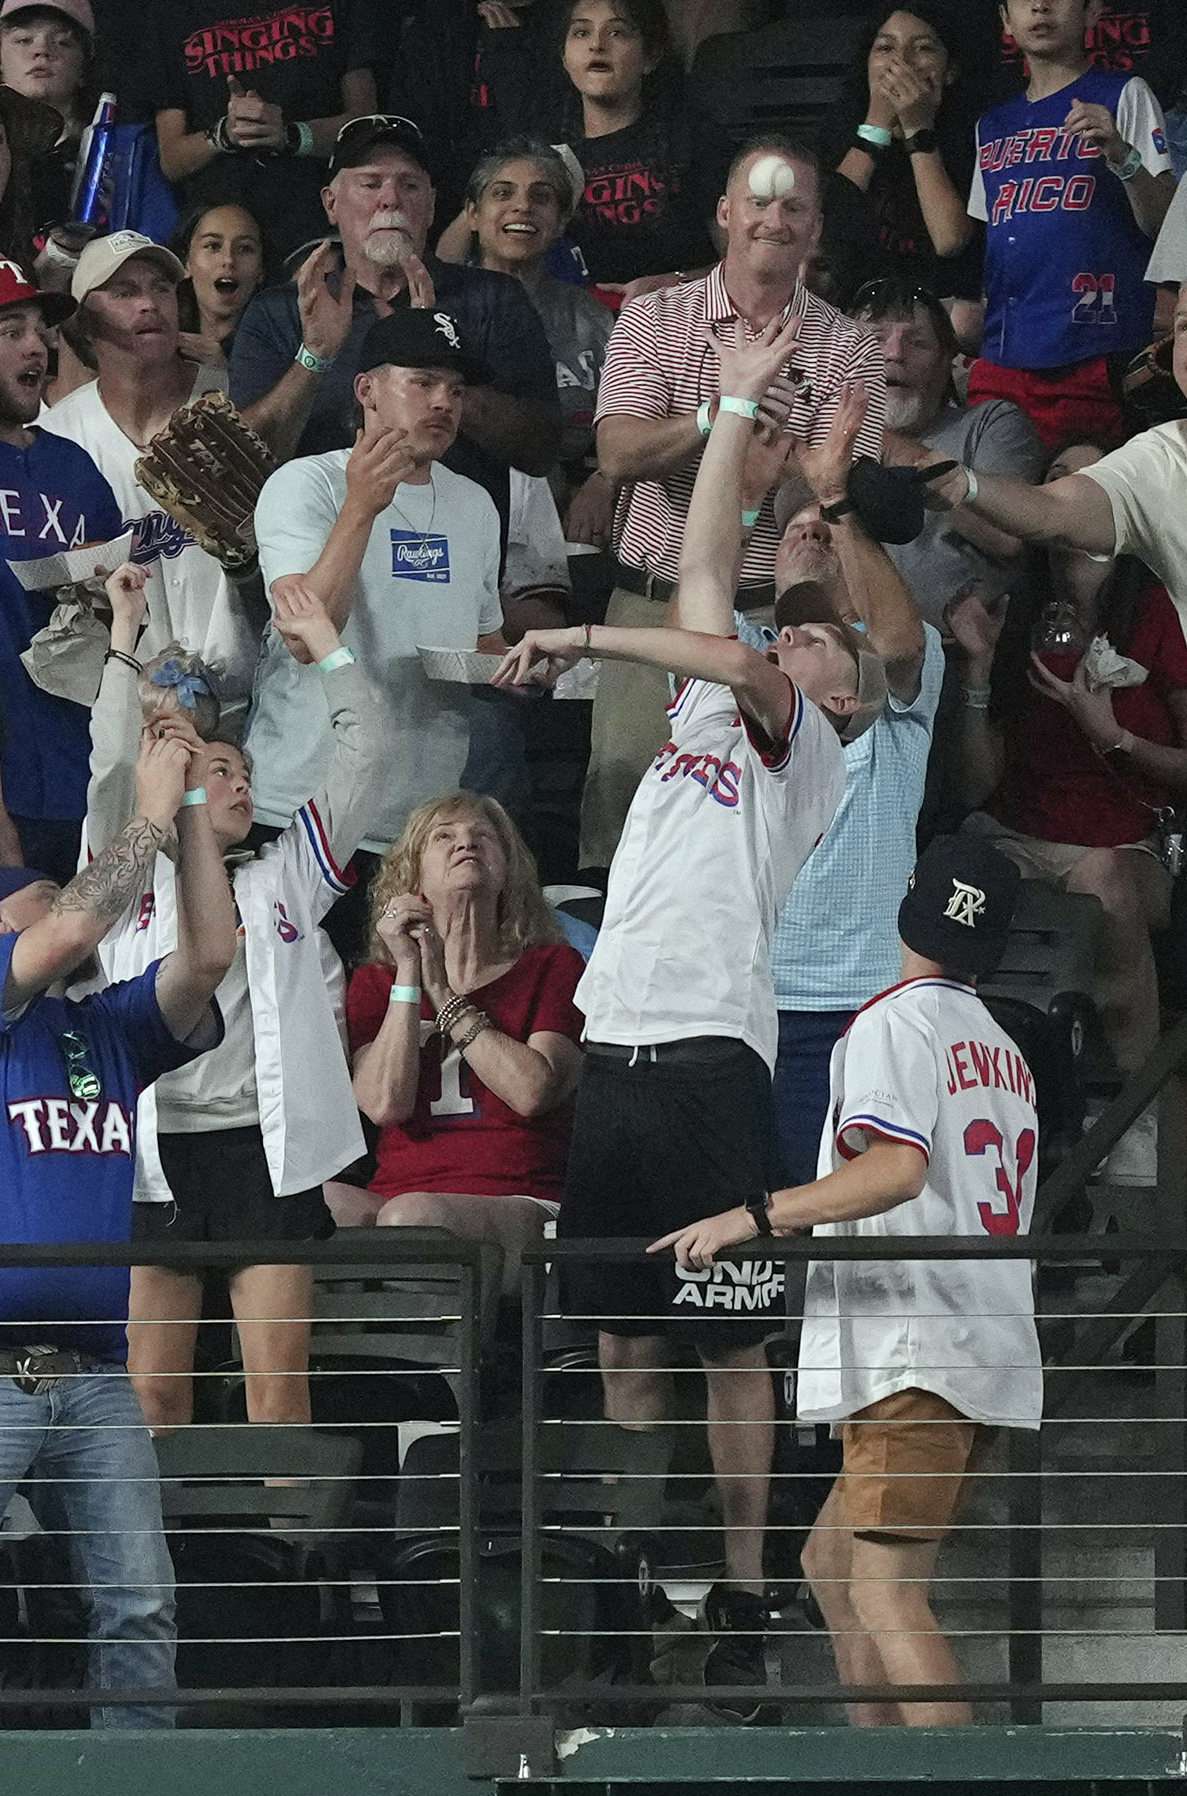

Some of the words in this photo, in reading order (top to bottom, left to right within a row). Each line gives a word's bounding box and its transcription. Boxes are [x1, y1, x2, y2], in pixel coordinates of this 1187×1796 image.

[180, 11, 335, 67] SINGING
[204, 36, 317, 77] THINGS
[991, 173, 1097, 222] RICO
[1072, 273, 1117, 324] 21
[396, 543, 446, 566] Rawlings
